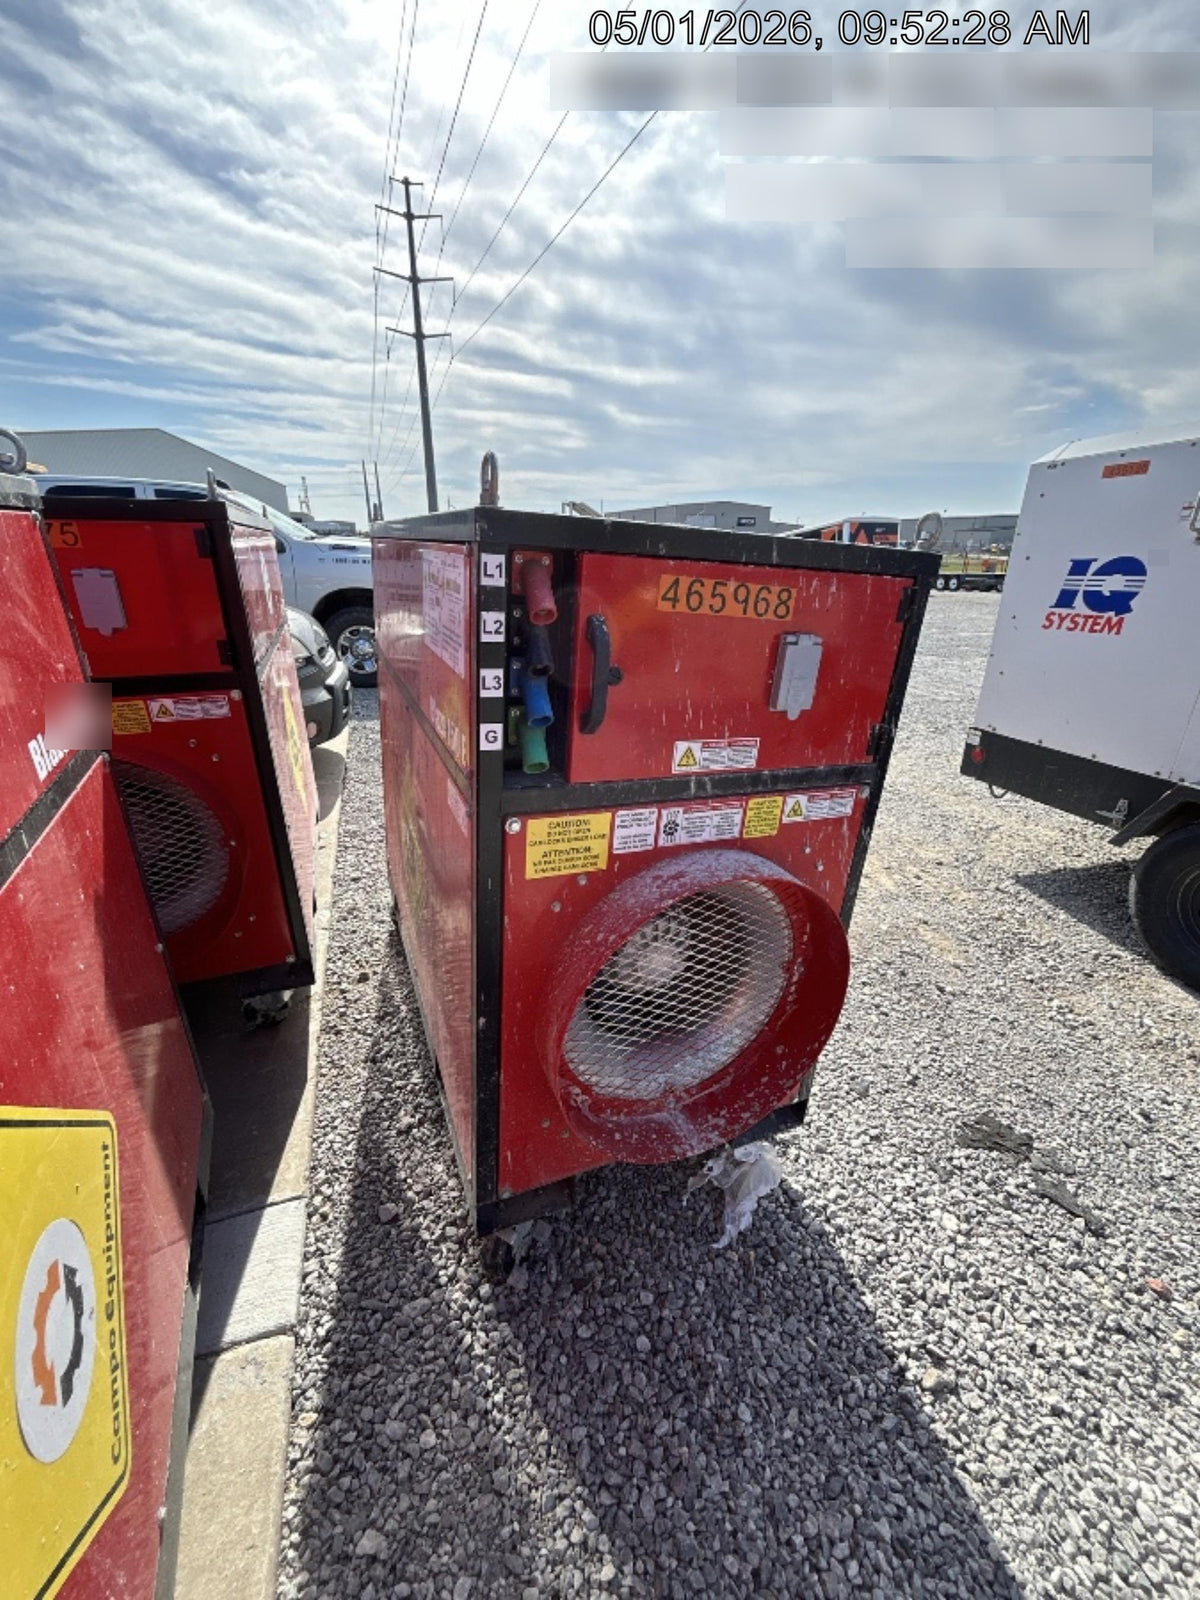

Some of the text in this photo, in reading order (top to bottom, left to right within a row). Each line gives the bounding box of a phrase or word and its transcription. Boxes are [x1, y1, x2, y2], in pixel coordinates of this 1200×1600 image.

[483, 561, 503, 579] L1
[1049, 555, 1147, 617] IQ
[661, 577, 792, 619] 465968
[483, 619, 503, 635] L2
[1041, 610, 1125, 635] SYSTEM
[481, 675, 502, 691] L3
[484, 729, 498, 744] G
[101, 1141, 121, 1466] Campo Equipment
